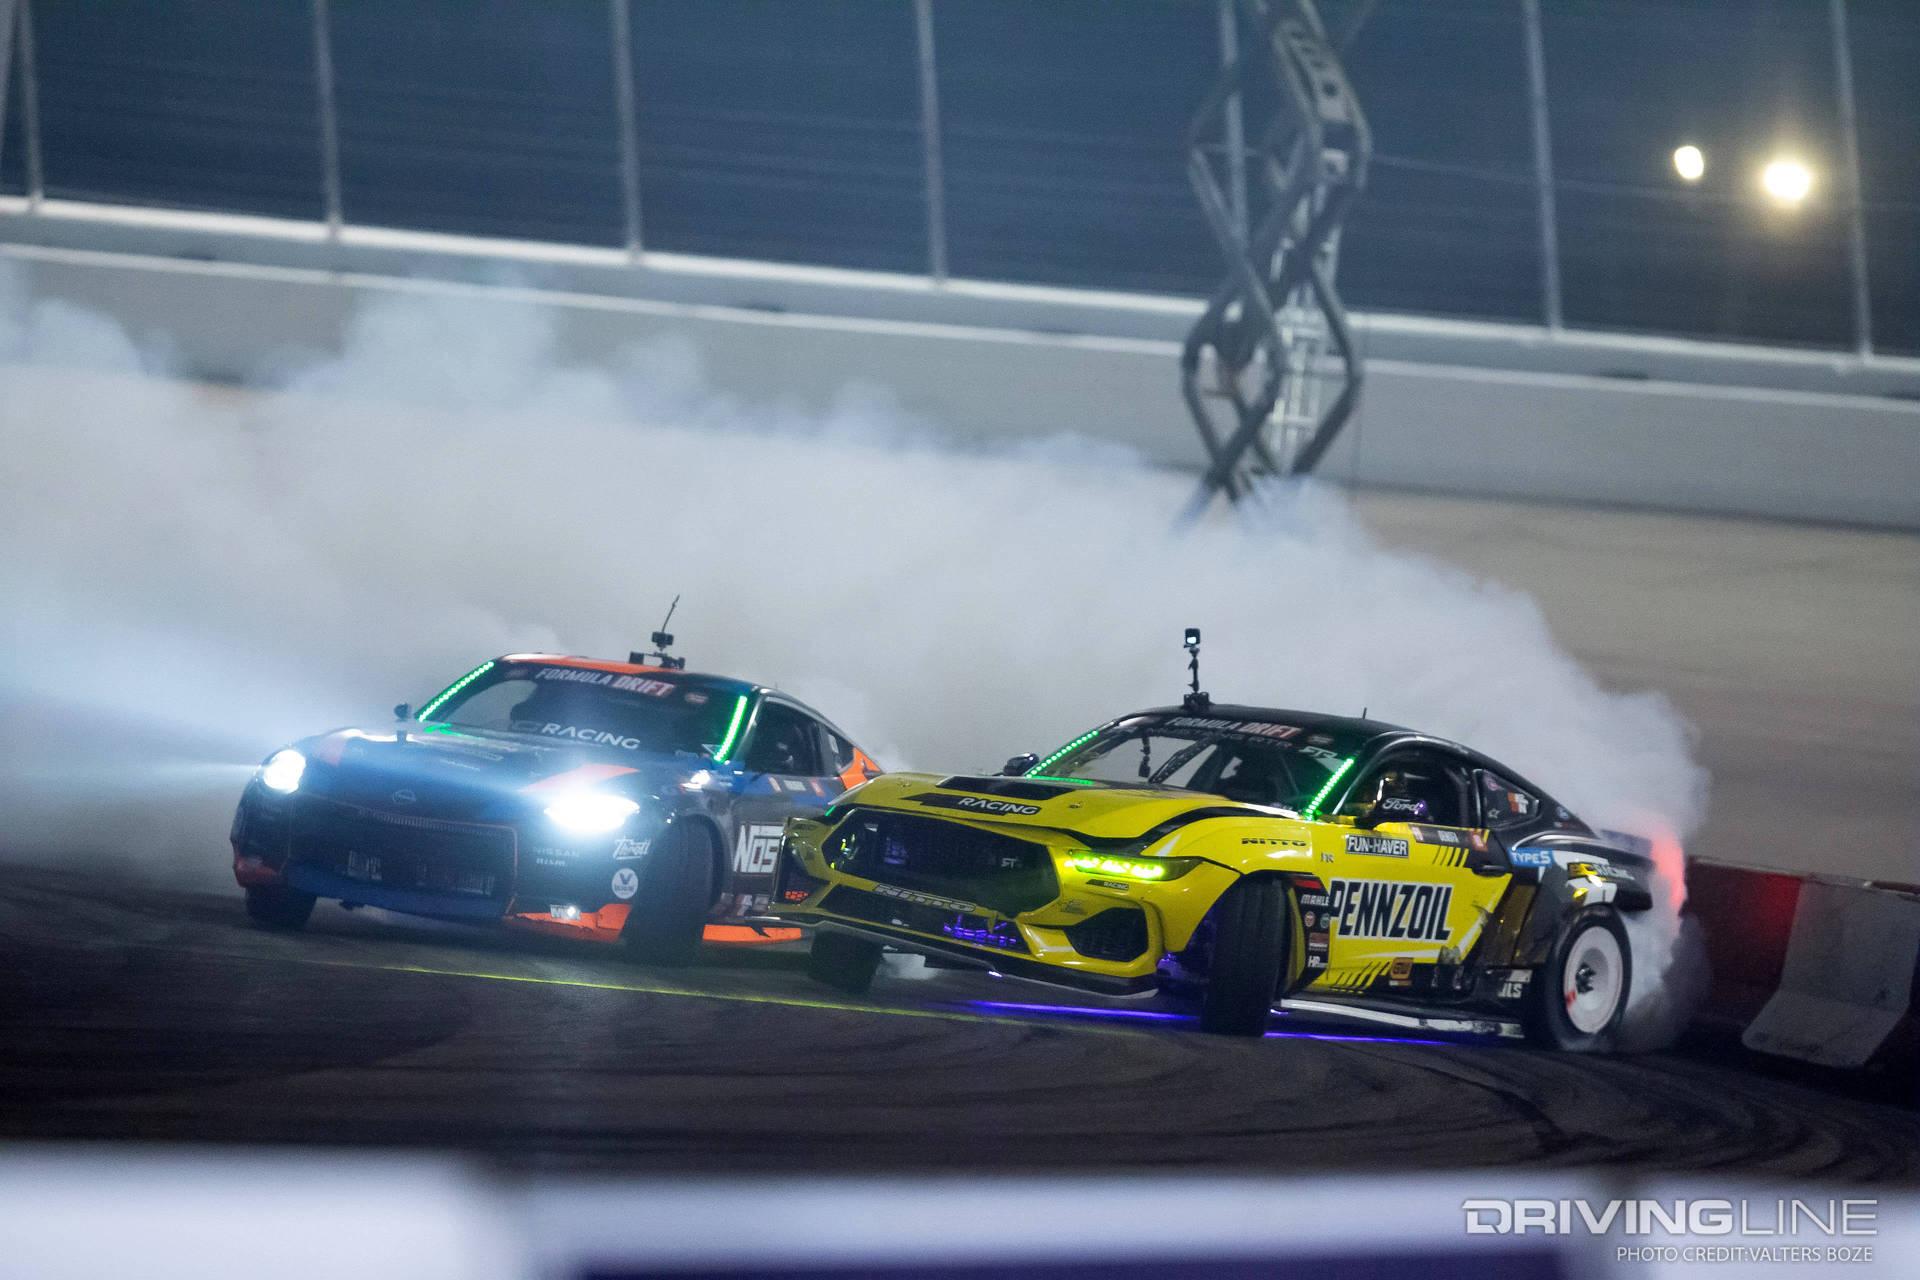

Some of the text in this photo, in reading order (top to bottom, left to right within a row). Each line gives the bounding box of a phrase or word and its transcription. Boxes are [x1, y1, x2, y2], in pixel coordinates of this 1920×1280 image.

[535, 667, 613, 686] FORMULA
[612, 677, 676, 696] DRIFT
[541, 723, 640, 750] RACING
[1239, 722, 1302, 739] DRIFT
[957, 797, 1039, 815] RACING
[1382, 798, 1421, 812] Ford
[1241, 838, 1307, 847] NITTO
[1349, 838, 1408, 857] FUN-HAVER
[1329, 879, 1454, 941] PENNZOIL
